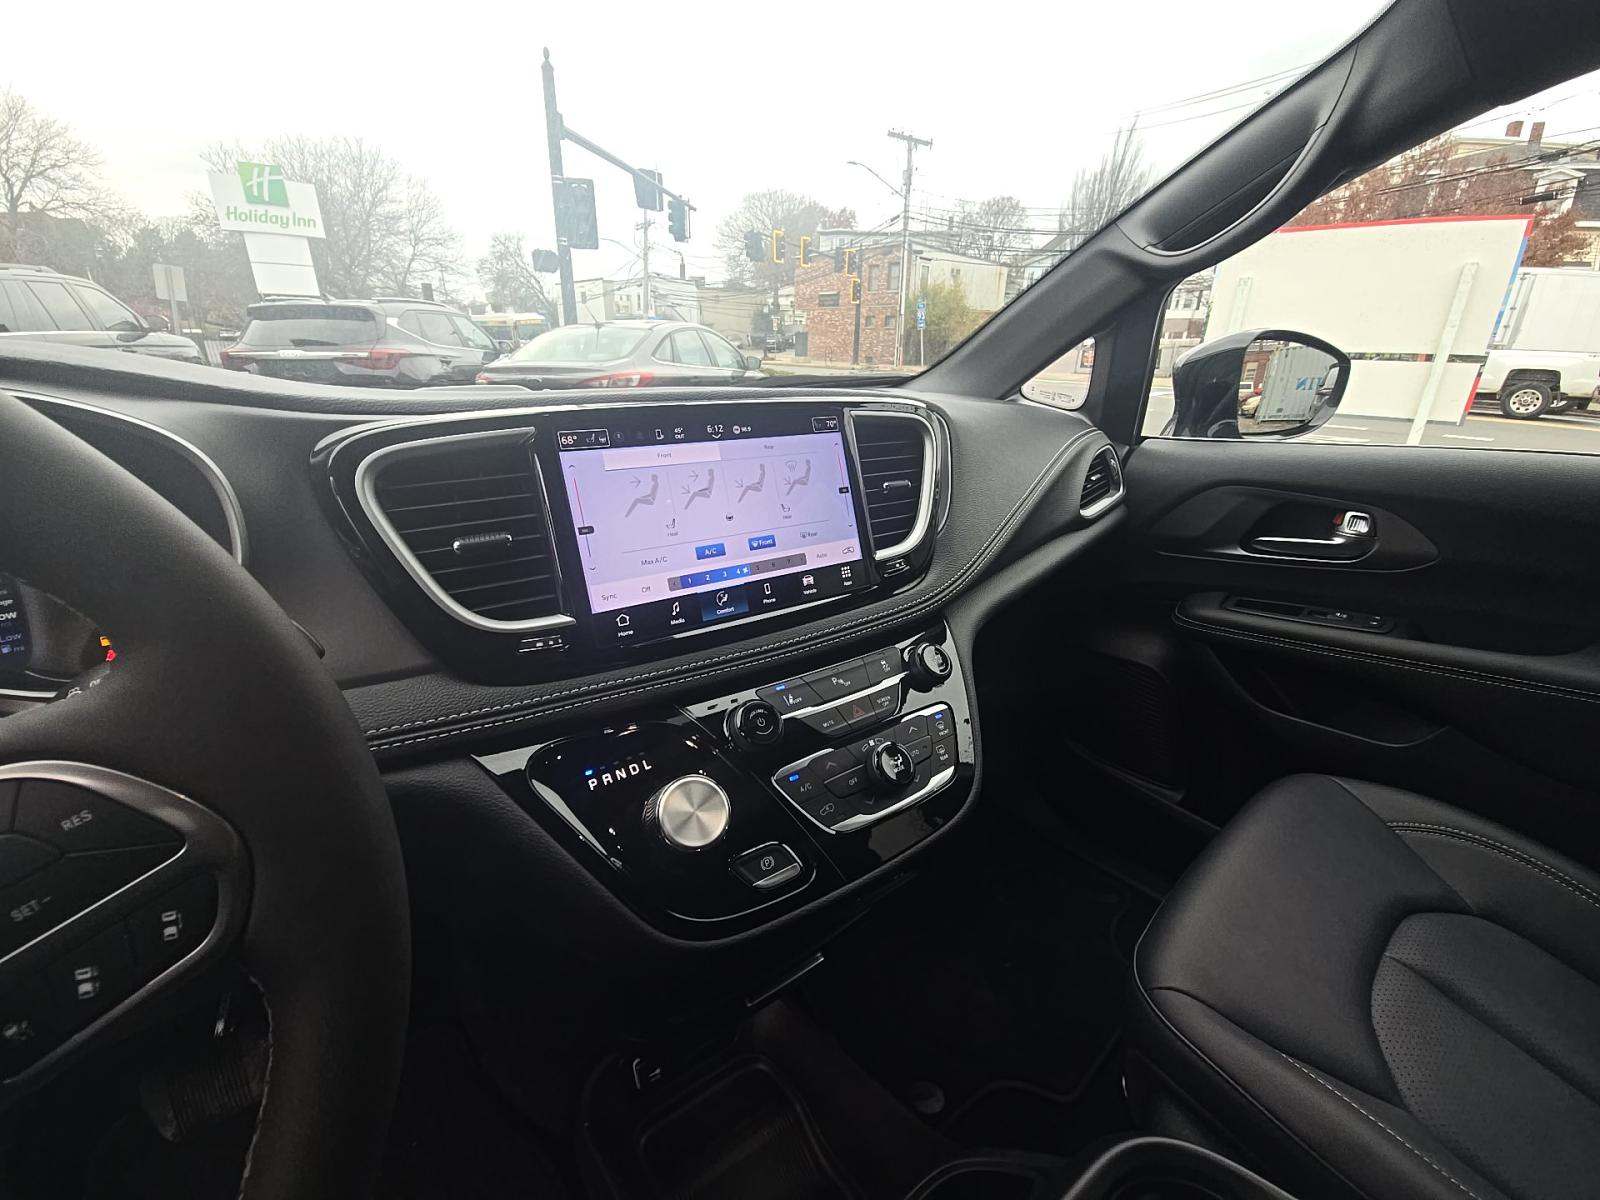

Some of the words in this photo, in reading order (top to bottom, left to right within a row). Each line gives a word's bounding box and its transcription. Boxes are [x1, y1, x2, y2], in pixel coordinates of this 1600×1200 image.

[225, 205, 290, 228] Holiday
[292, 211, 317, 228] Inn
[706, 424, 724, 434] 6:12
[561, 434, 578, 445] 68°
[759, 538, 773, 546] Front
[704, 548, 717, 556] A/C
[654, 556, 668, 564] A/C
[601, 594, 617, 602] Sync
[716, 606, 735, 615] Comfort
[670, 617, 685, 625] Media
[618, 629, 634, 637] Home
[822, 720, 835, 728] MUTE
[848, 777, 858, 786] OFF
[800, 782, 813, 792] A/C
[60, 809, 93, 831] RES
